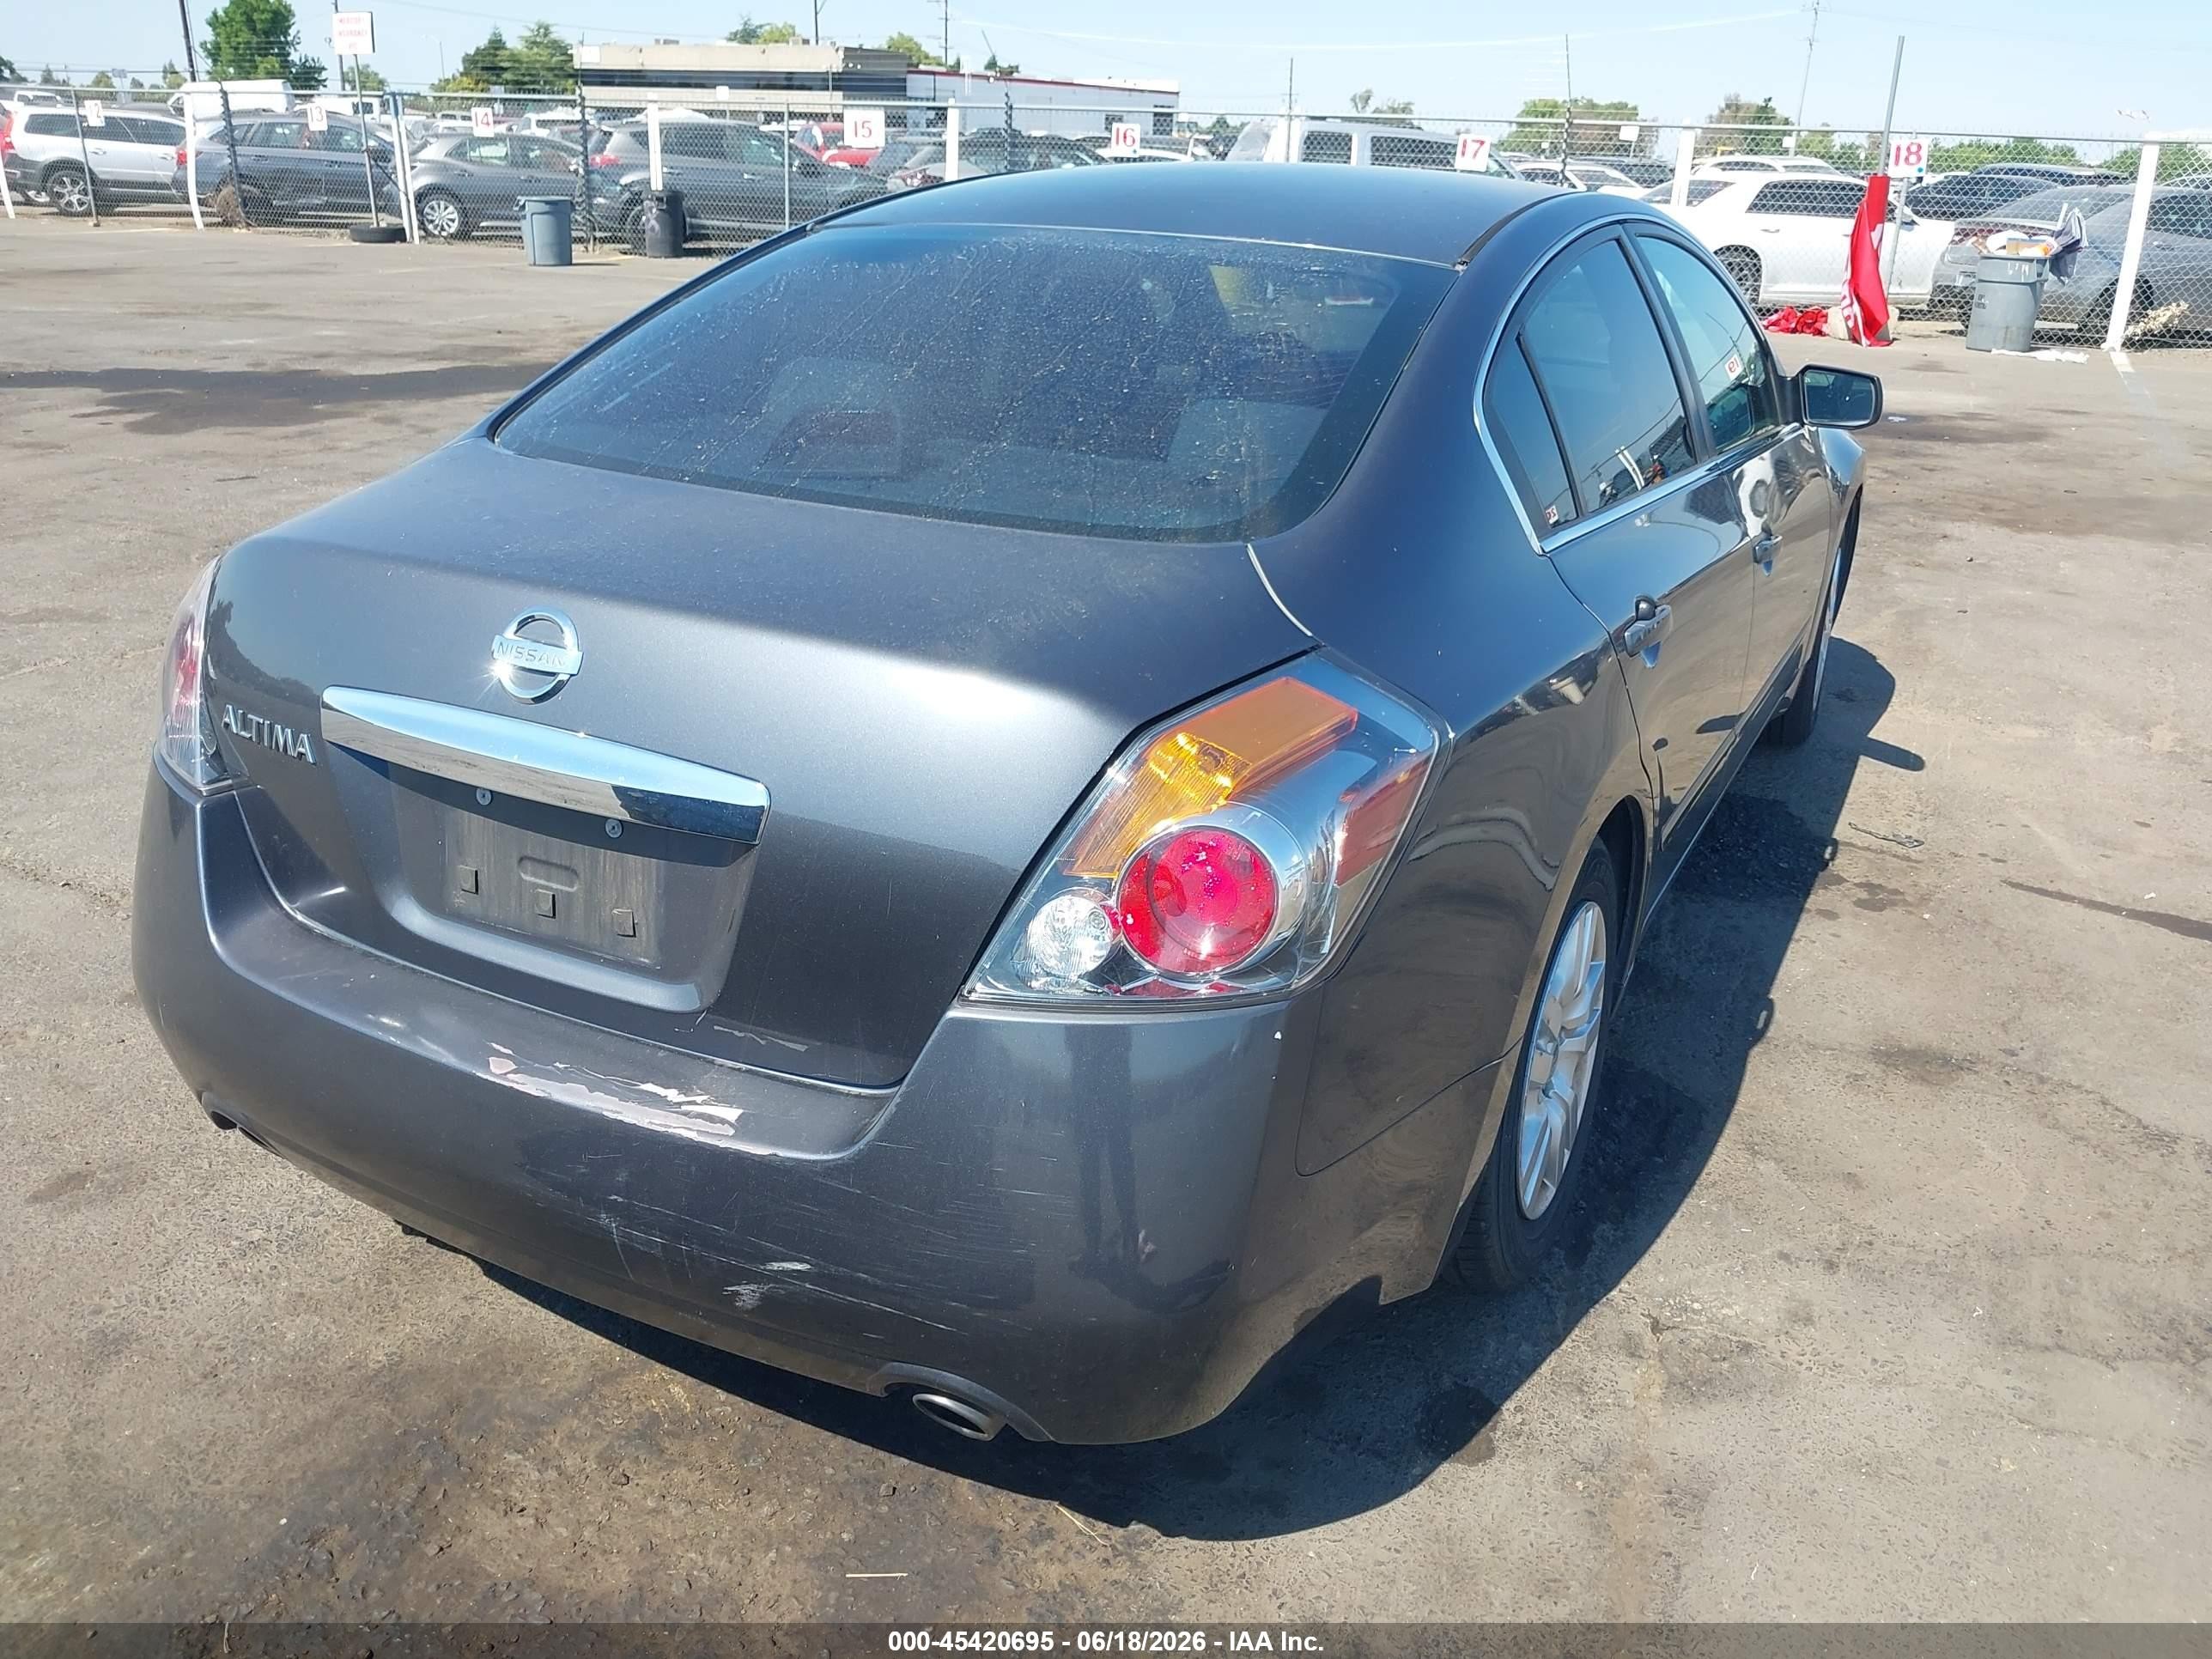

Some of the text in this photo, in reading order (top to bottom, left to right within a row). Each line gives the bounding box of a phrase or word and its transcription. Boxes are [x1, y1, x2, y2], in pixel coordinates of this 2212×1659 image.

[310, 106, 324, 123] 13
[475, 111, 491, 128] 14
[854, 120, 872, 138] 15
[1115, 126, 1136, 147] 16
[1461, 137, 1486, 160] 17
[1894, 142, 1922, 167] 18
[497, 641, 567, 667] NISSAN
[222, 703, 317, 765] ALTIMA
